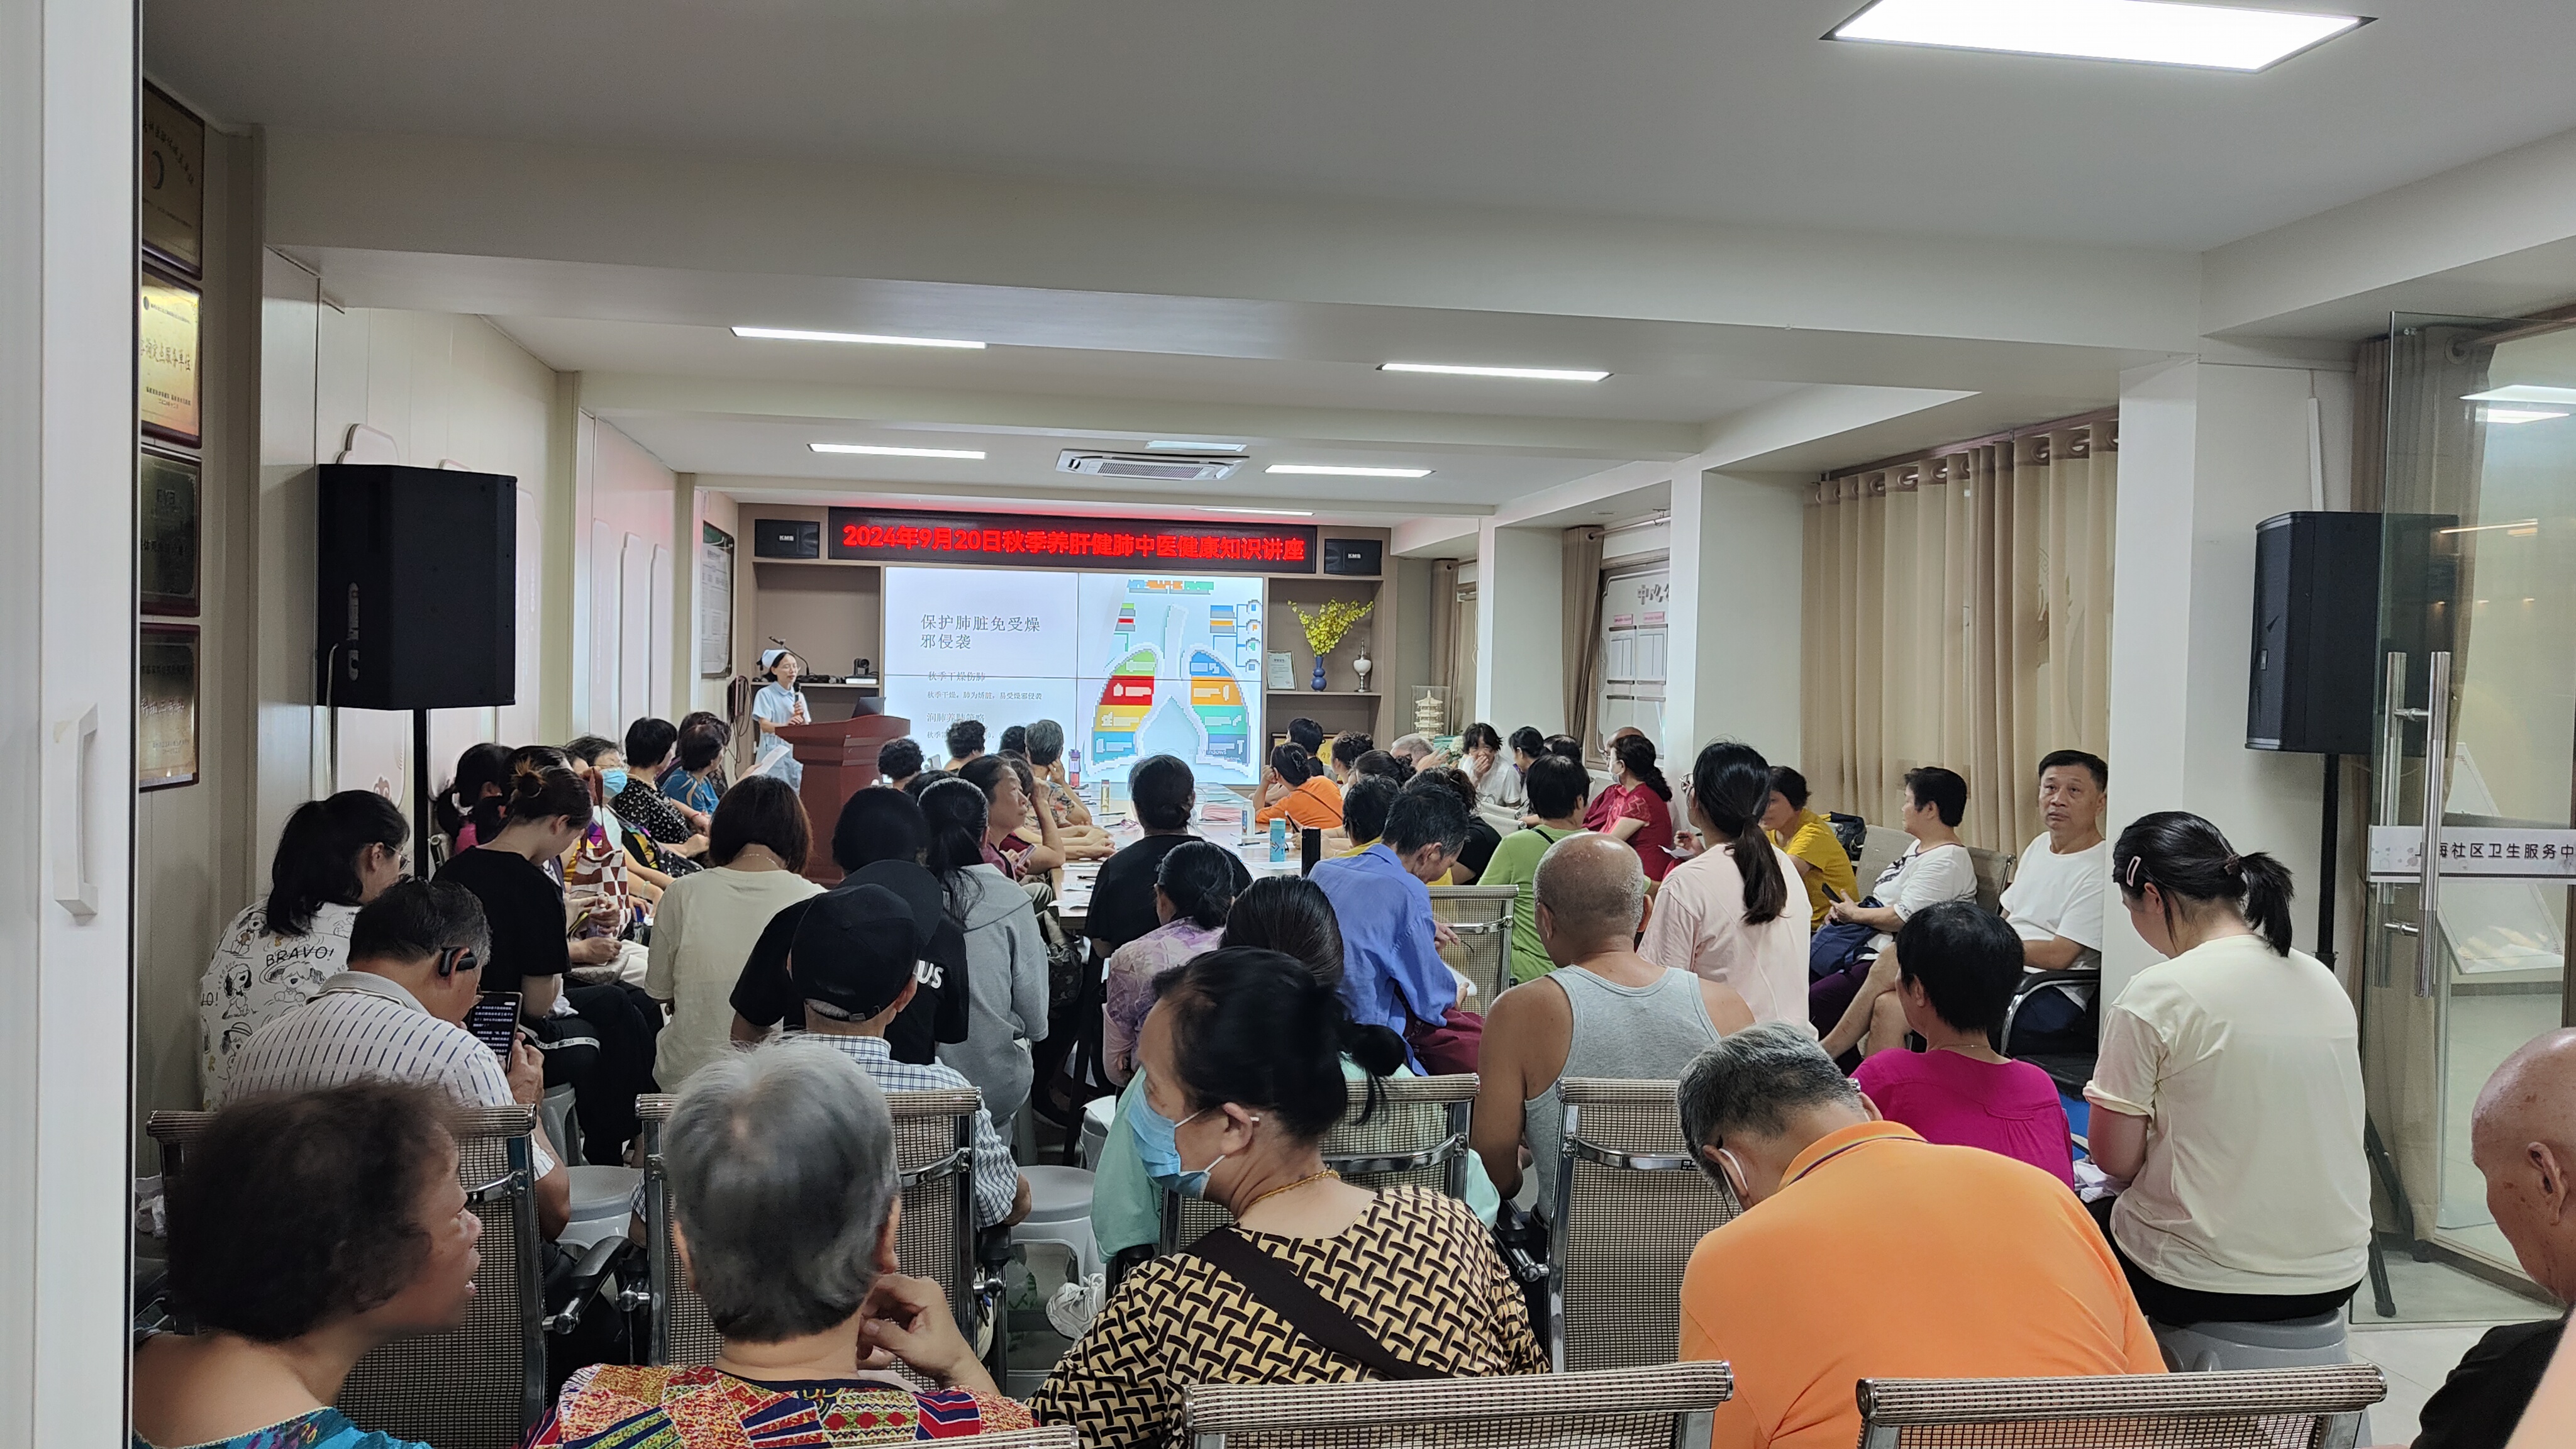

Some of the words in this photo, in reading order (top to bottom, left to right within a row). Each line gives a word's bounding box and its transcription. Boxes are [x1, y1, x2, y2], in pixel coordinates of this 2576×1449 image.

[843, 525, 1306, 561] 2024年9月20日秋季养肝健肺中医健康知识讲座
[921, 614, 1040, 632] 保护肺脏免受燥
[920, 633, 971, 649] 邪侵袭
[928, 671, 985, 682] 秋季干燥伤肺
[266, 945, 335, 967] BRAVO!
